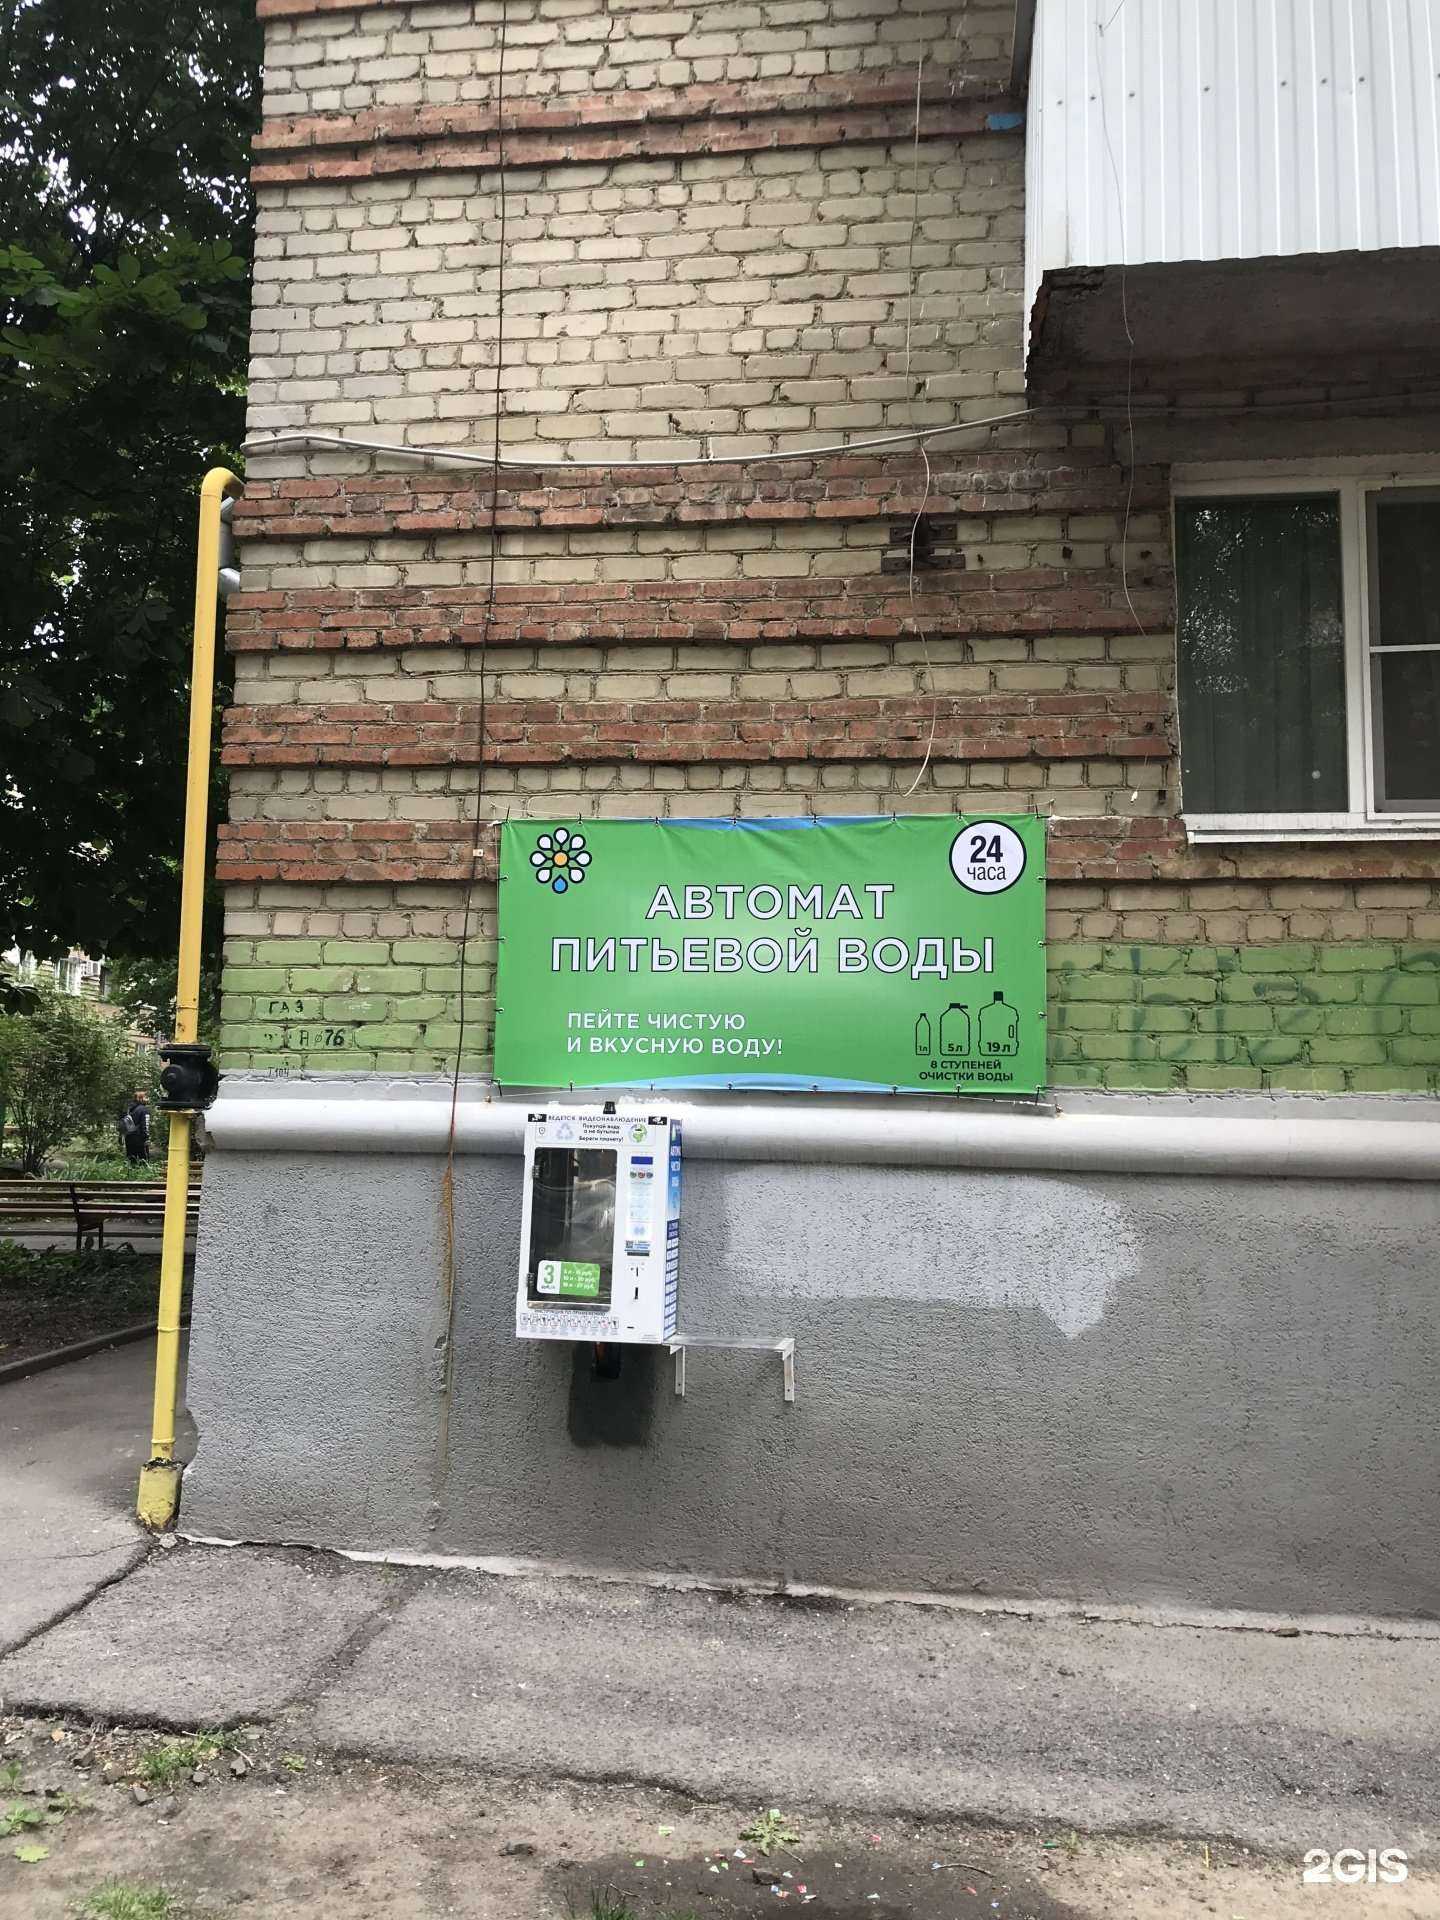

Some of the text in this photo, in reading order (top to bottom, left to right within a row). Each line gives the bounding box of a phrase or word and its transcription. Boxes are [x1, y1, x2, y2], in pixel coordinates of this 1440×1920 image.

[970, 835, 1003, 863] 24
[967, 866, 1007, 881] часа
[645, 884, 895, 920] АВТОМАТ
[551, 928, 994, 980] ПИТЬЕВОЙ ВОДЫ
[268, 1000, 304, 1014] ГАЗ
[567, 1008, 746, 1030] ПЕЙТЕ ЧИСТУЮ
[567, 1037, 783, 1058] И ВКУСНУЮ ВОДУ!
[930, 1059, 1002, 1070] 8 СТУПЕНЕЙ
[919, 1071, 1013, 1082] ОЧИСТКИ ВОДЫ
[543, 1264, 555, 1284] 3
